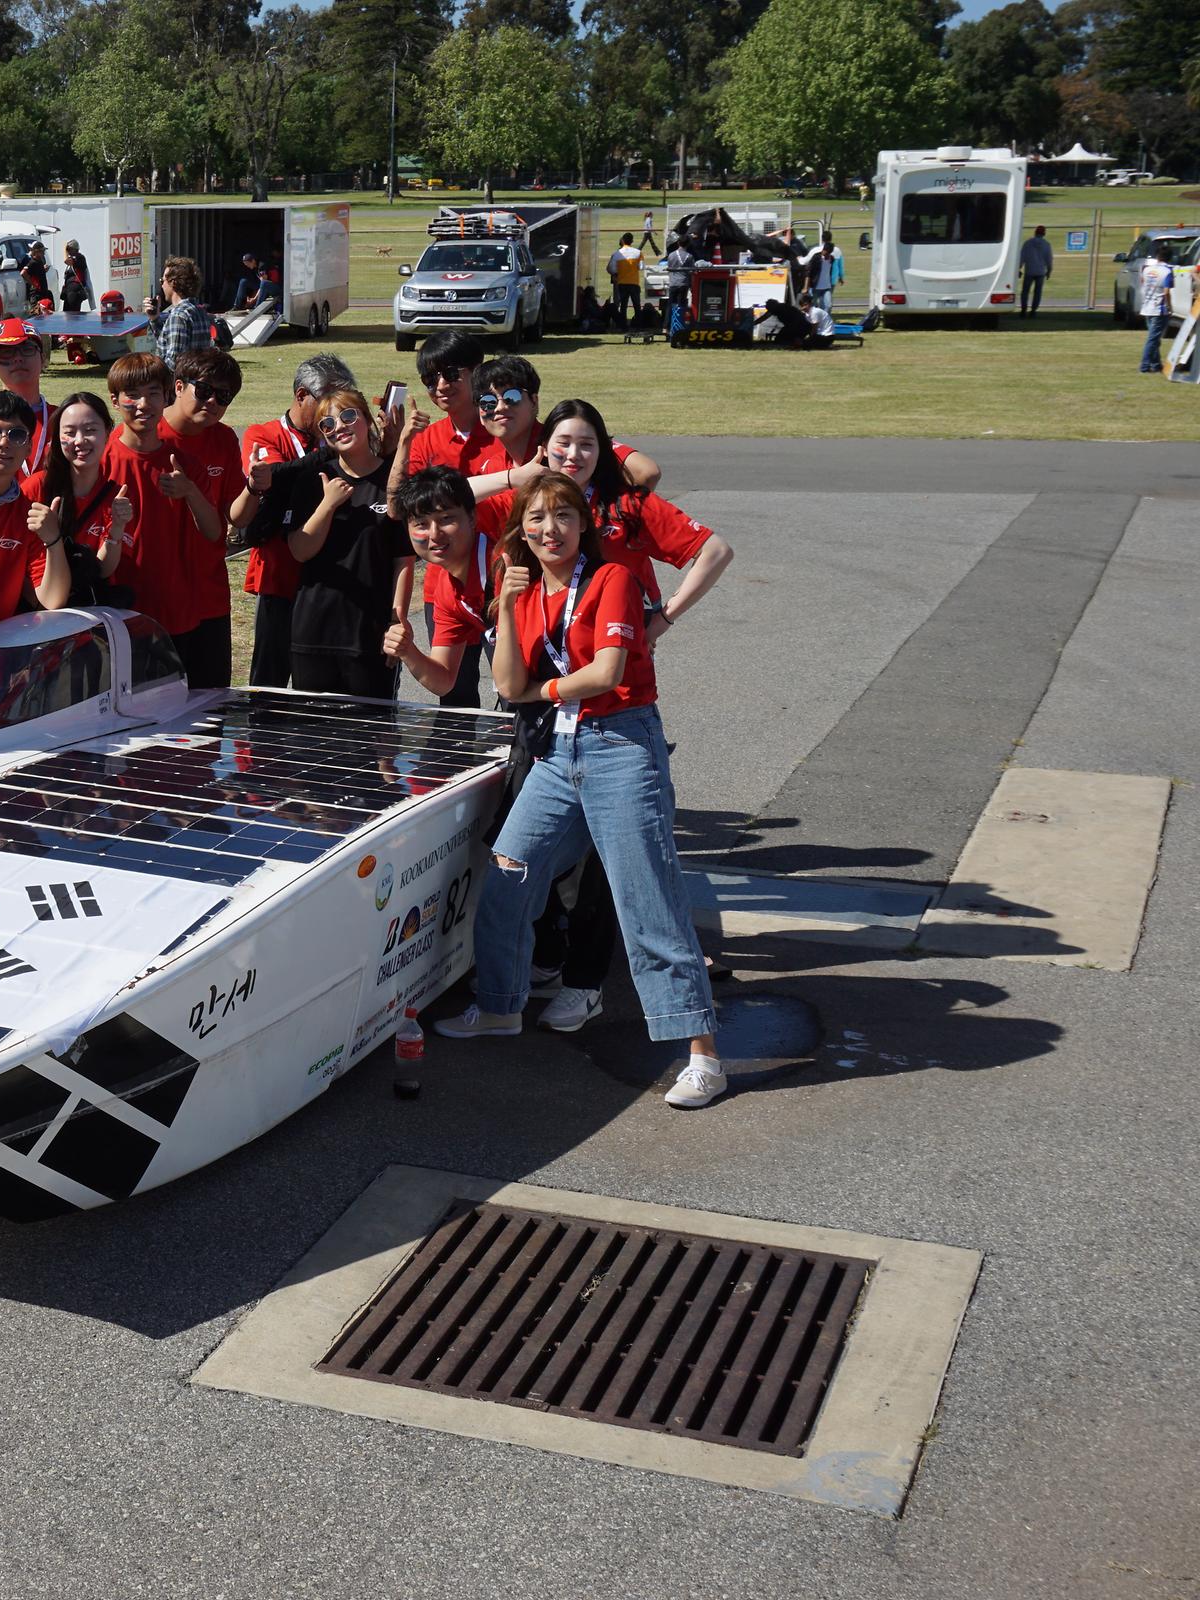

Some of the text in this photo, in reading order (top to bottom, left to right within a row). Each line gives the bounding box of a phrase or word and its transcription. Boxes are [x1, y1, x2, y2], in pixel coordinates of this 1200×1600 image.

[111, 236, 141, 256] PODS
[688, 330, 735, 342] STC-3
[400, 847, 441, 889] KOOKMIN
[424, 890, 441, 909] WORLD
[442, 867, 472, 935] 82
[377, 942, 416, 987] CHALLENGER
[414, 930, 435, 959] CLASS
[188, 969, 257, 1040] 만세
